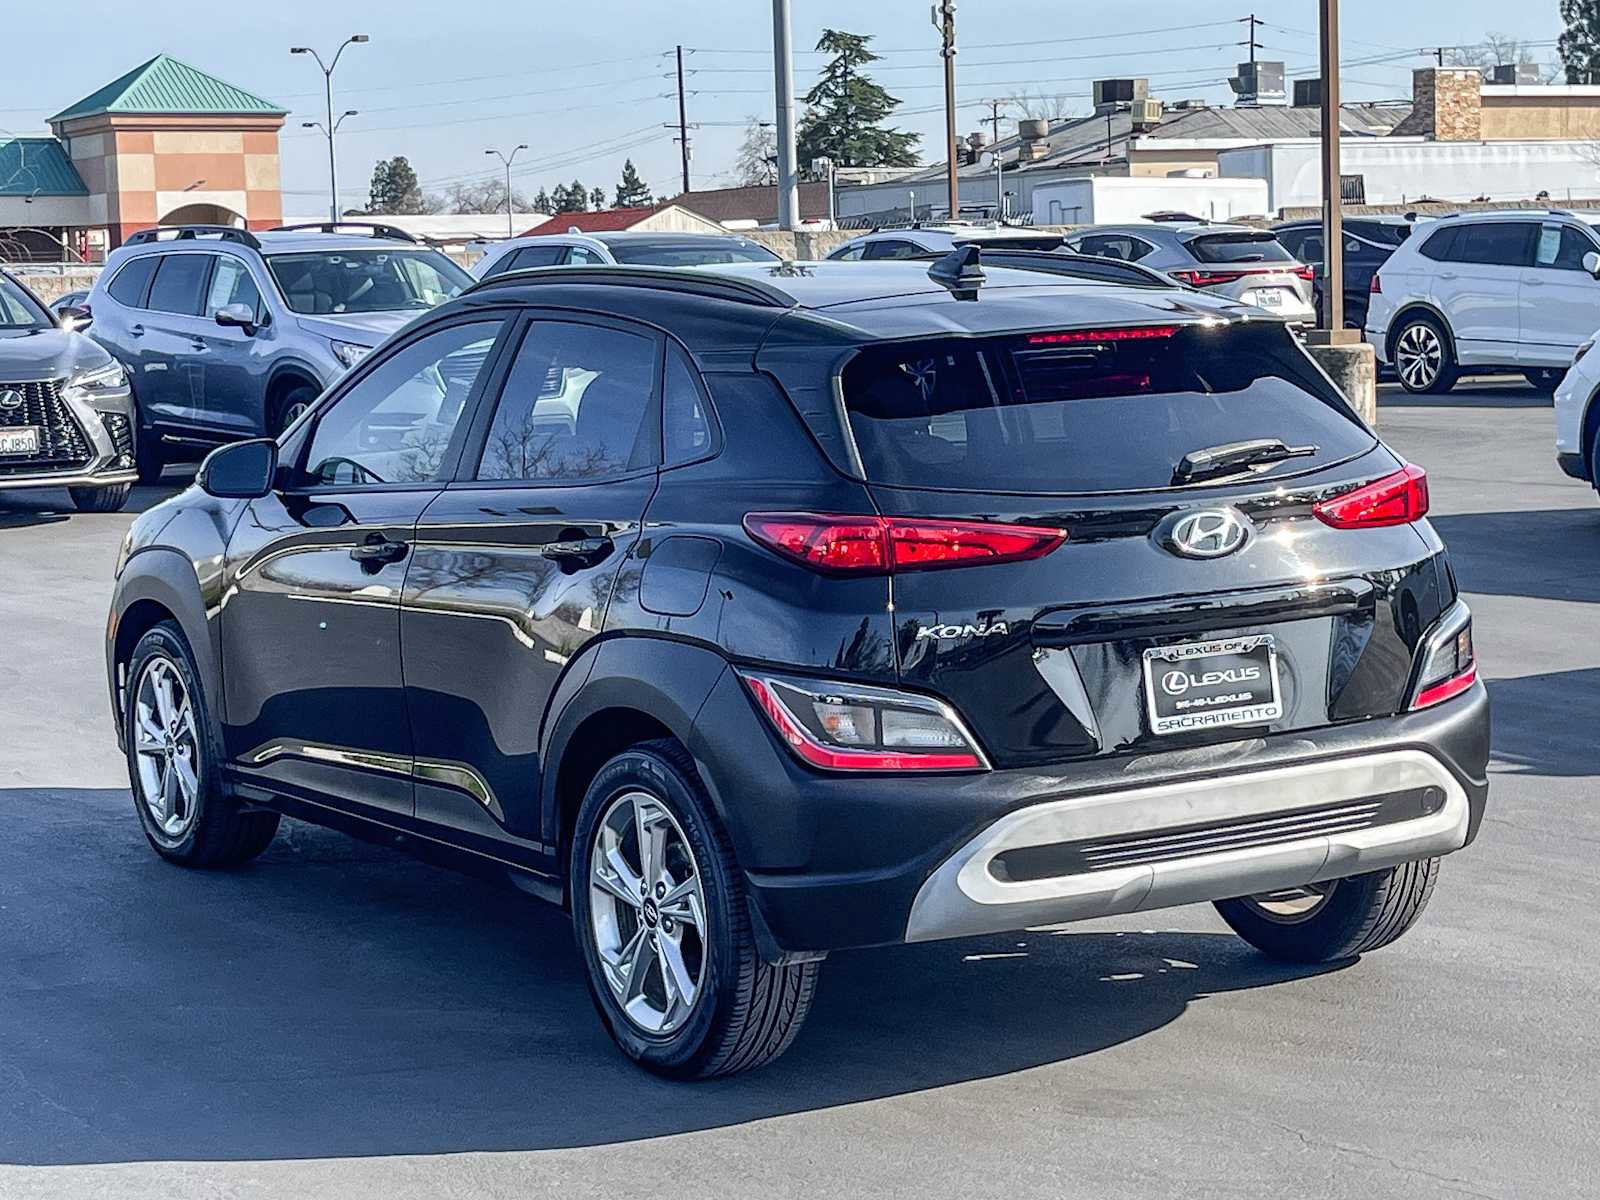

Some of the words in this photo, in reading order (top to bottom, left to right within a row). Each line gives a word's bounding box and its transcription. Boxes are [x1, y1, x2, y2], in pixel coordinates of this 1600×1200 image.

[915, 622, 1008, 640] KONA
[1177, 644, 1221, 657] LEXUS
[1224, 642, 1242, 651] OF
[1190, 667, 1260, 687] LEXUS
[1158, 707, 1277, 731] SACRAMENTO
